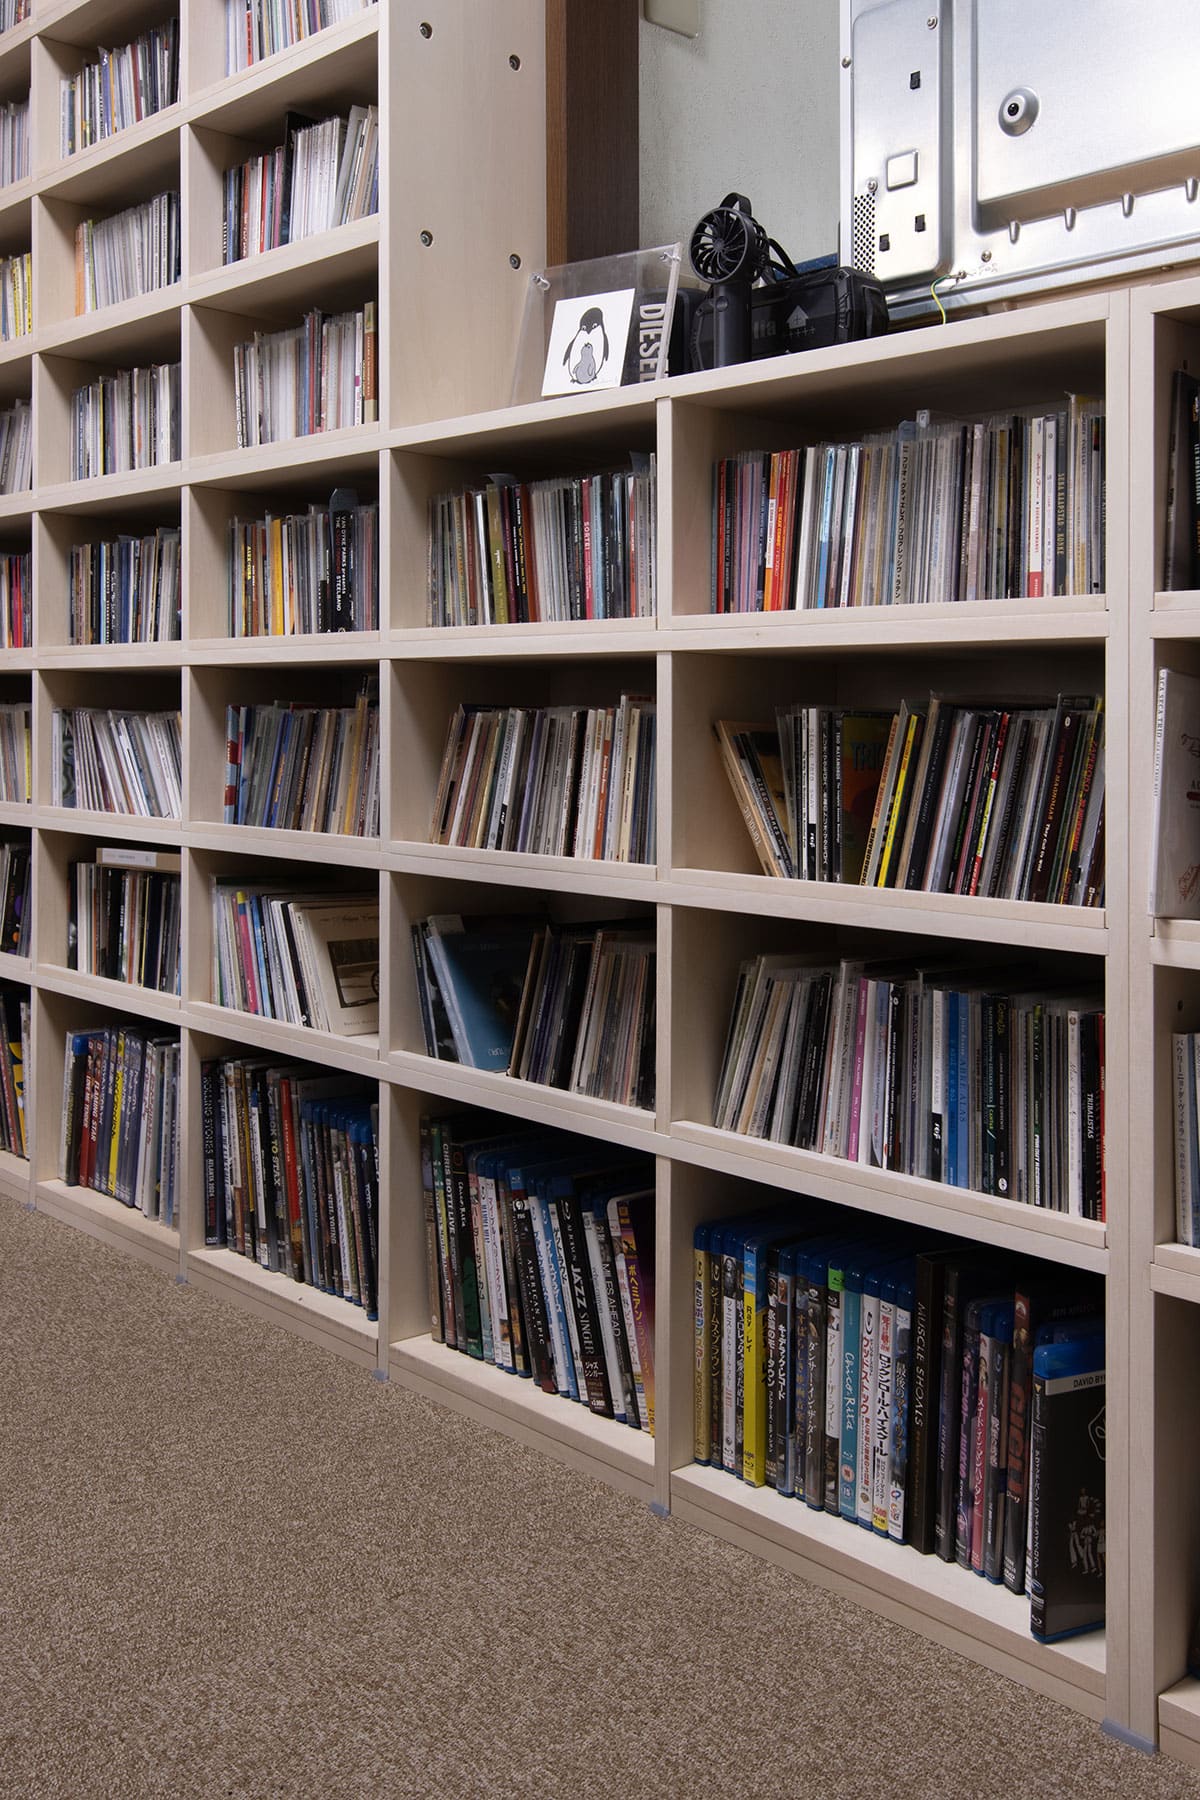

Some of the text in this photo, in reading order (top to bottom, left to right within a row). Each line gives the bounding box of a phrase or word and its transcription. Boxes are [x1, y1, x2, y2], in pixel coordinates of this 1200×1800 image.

[1040, 838, 1048, 850] Call
[1042, 822, 1050, 838] They
[1036, 858, 1044, 872] Wild
[203, 1077, 213, 1116] ROLLING
[90, 1119, 98, 1142] STAR
[1085, 1092, 1094, 1139] TRIBALISTAS
[204, 1118, 215, 1154] STONES
[271, 1139, 279, 1154] TO
[272, 1155, 281, 1187] STAX
[442, 1143, 452, 1176] CHRIS
[444, 1178, 455, 1211] BOTTI
[447, 1213, 458, 1242] LIVE
[527, 1258, 545, 1346] AMERICAN EPIC
[571, 1264, 595, 1355] JAZZ SINGER
[602, 1263, 622, 1338] MILES AHEAD
[913, 1301, 926, 1428] MUSCLE SHOALS
[1073, 1377, 1094, 1388] DAVID
[844, 1394, 856, 1431] Rita
